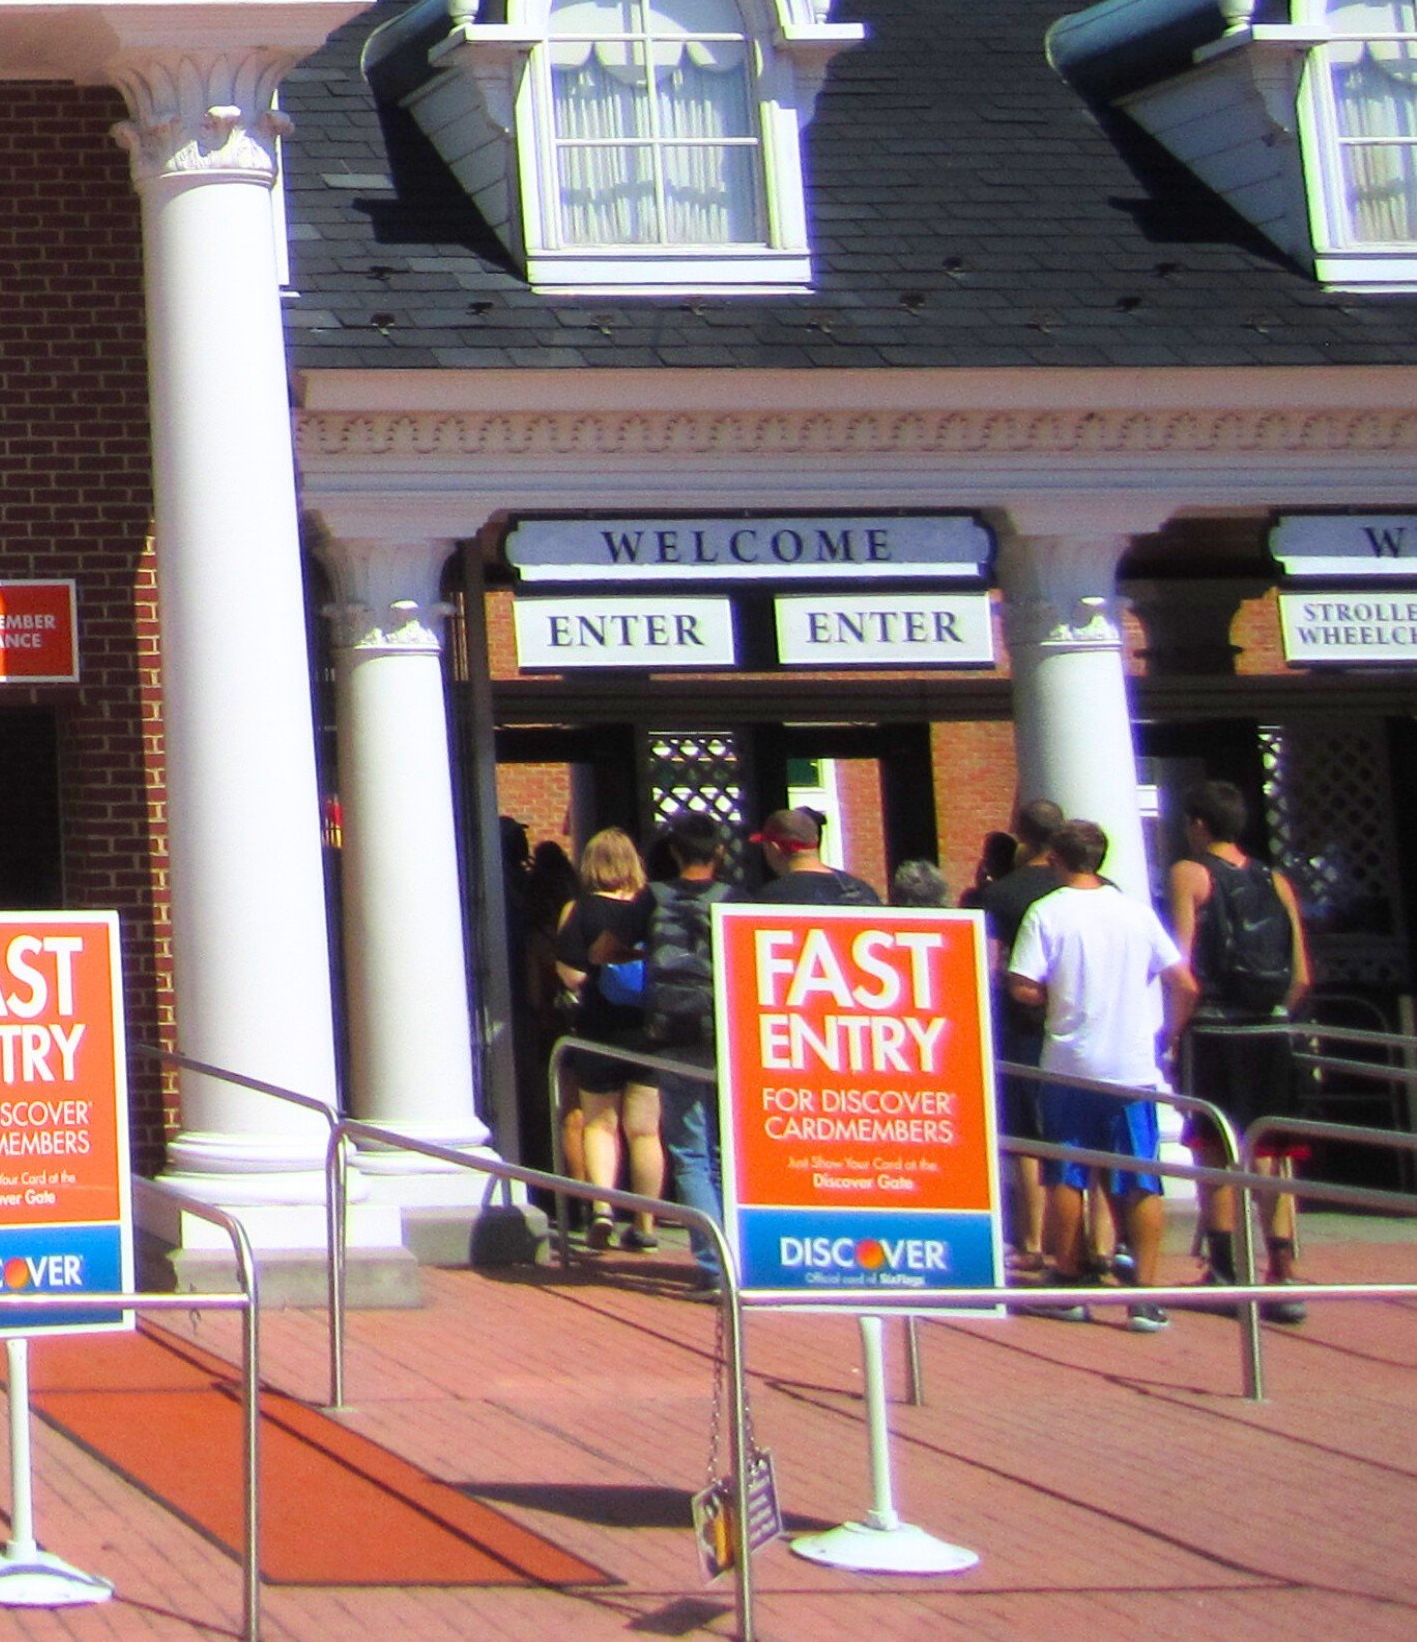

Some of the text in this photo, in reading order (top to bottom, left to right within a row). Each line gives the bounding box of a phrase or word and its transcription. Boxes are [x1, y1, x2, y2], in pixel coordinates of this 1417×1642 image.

[600, 528, 894, 563] WELCOME
[547, 614, 705, 647] ENTER
[805, 610, 963, 644] ENTER
[754, 928, 943, 1009] FAST
[758, 1013, 947, 1073] ENTRY
[762, 1087, 953, 1116] FOR DISCOVER
[764, 1117, 954, 1144] CARDMEMBERS
[20, 1170, 47, 1186] Card
[48, 1172, 59, 1184] at
[60, 1169, 76, 1184] the
[811, 1155, 842, 1169] Show
[844, 1157, 870, 1169] Your
[873, 1157, 902, 1170] Card
[24, 1189, 56, 1205] Gate
[813, 1173, 914, 1190] Discover Gate
[779, 1236, 947, 1270] DISCOVER
